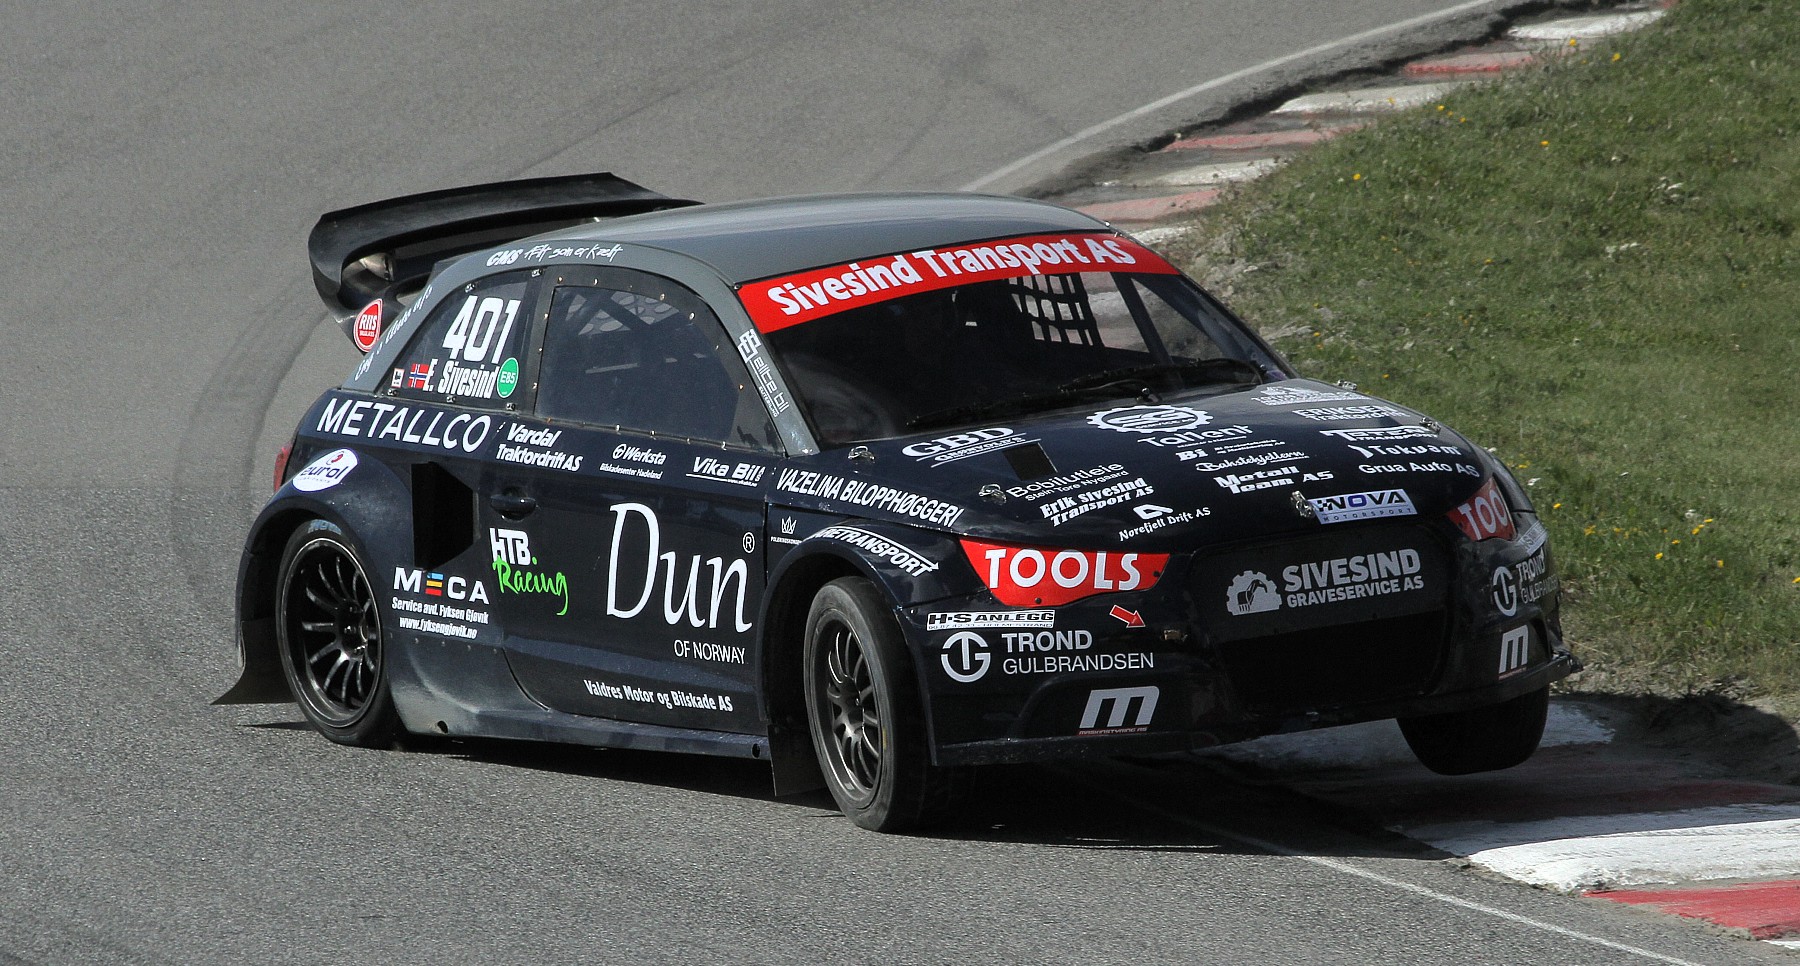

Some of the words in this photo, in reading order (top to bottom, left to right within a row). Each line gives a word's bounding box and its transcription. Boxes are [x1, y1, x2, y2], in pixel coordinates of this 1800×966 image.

[767, 254, 923, 316] Sivesind
[913, 239, 1091, 275] Transport
[1084, 239, 1137, 265] AS
[358, 313, 378, 330] RIIS
[442, 295, 521, 364] 401
[423, 358, 439, 392] E.
[437, 360, 500, 399] Sivesind
[499, 370, 516, 384] E85
[316, 398, 491, 453] METALLCO
[506, 422, 562, 448] Vardal
[622, 445, 667, 466] Werksta
[902, 427, 1014, 457] GBD
[692, 457, 730, 478] Vika
[732, 463, 761, 482] Bil
[1006, 462, 1124, 498] Bobilutleie
[1213, 465, 1300, 488] Metall
[1228, 478, 1295, 494] Team
[1303, 470, 1335, 483] AS
[1359, 463, 1407, 475] Grua
[1409, 461, 1453, 472] Auto
[1455, 463, 1480, 478] AS
[776, 467, 844, 500] VAZELINA
[840, 480, 965, 527] BILOPPHØGGERI
[1040, 494, 1078, 518] Erik
[1078, 478, 1148, 504] Sivesind
[1050, 493, 1131, 527] Transport
[1135, 485, 1155, 499] AS
[1325, 491, 1406, 511] NOVA
[1118, 518, 1166, 542] Norefjell
[1166, 511, 1194, 526] Drift
[1195, 507, 1211, 518] AS
[1323, 508, 1411, 521] MOTORSPORT
[489, 527, 531, 566] HTB
[607, 502, 752, 633] Dun
[985, 548, 1141, 591] TOOLS
[1282, 548, 1421, 592] SIVESIND
[492, 555, 569, 616] Racing
[1286, 579, 1401, 608] GRAVESERVICE
[1403, 575, 1425, 590] AS
[392, 596, 423, 613] Service
[439, 605, 465, 621] Fyksen
[975, 613, 1054, 621] ANLEGG
[674, 639, 691, 658] OF
[693, 641, 745, 665] NORWAY
[1001, 630, 1093, 653] TROND
[1002, 652, 1154, 675] GULBRANDSEN
[584, 679, 624, 700] Valdres
[622, 684, 655, 703] Motor
[656, 692, 673, 710] og
[670, 690, 717, 710] Bilskade
[718, 695, 733, 712] AS
